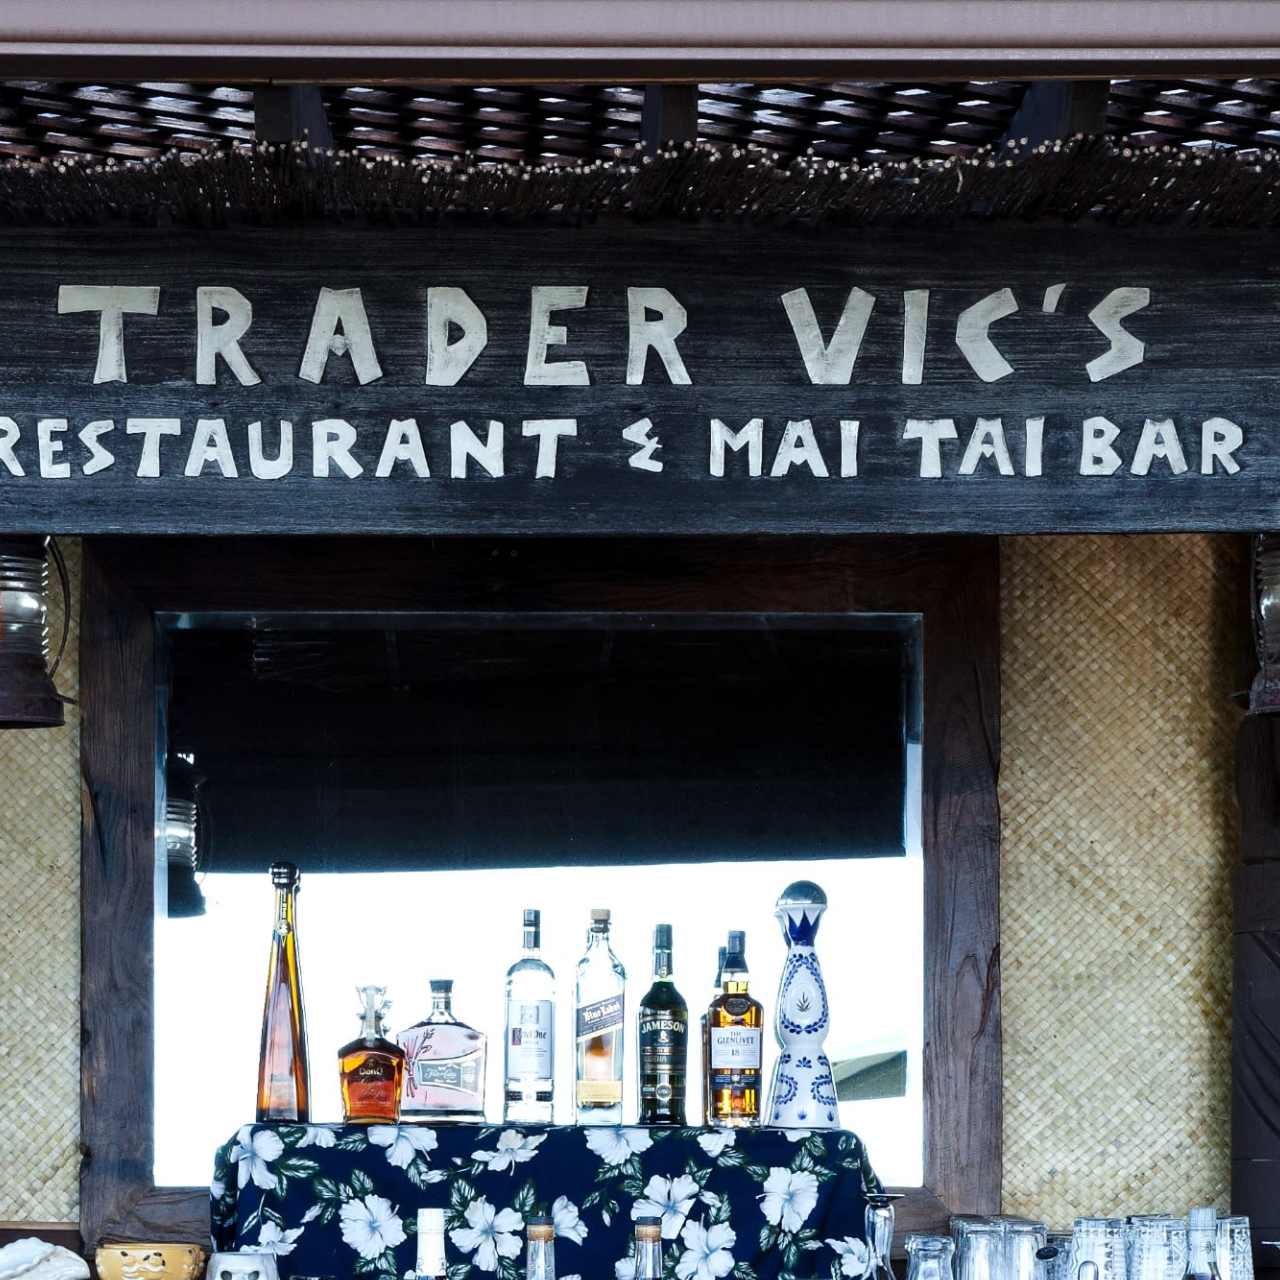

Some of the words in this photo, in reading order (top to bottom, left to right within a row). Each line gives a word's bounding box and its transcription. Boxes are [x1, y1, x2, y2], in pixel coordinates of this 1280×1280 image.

[56, 283, 694, 388] TRADER
[779, 283, 1151, 386] VIC'S
[620, 416, 665, 474] &
[708, 416, 861, 479] MAI
[901, 416, 1046, 479] TAI
[1078, 415, 1245, 477] BAR
[641, 1020, 685, 1034] JAMESON
[717, 1036, 754, 1045] GLENLIVET
